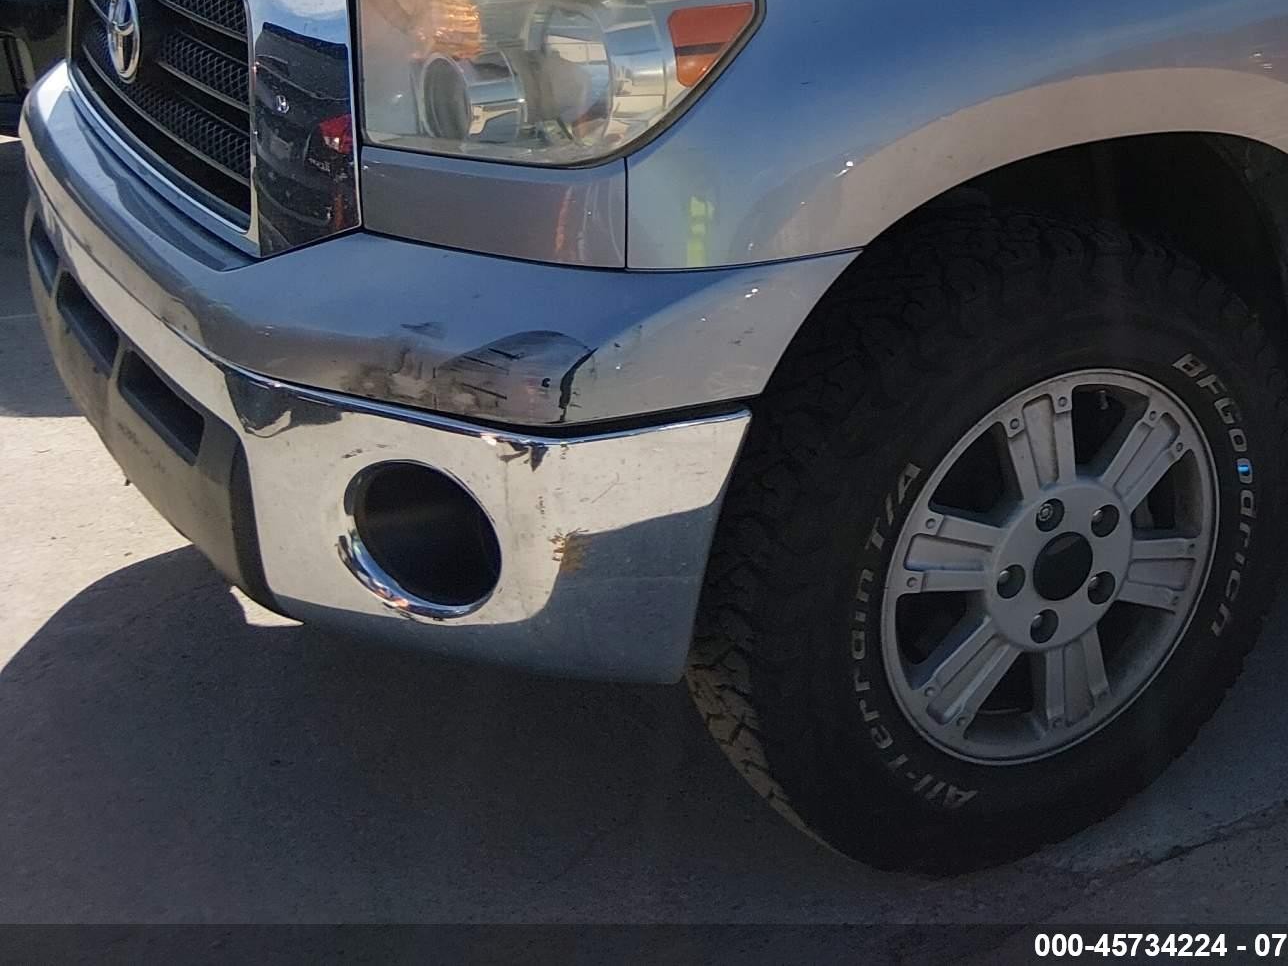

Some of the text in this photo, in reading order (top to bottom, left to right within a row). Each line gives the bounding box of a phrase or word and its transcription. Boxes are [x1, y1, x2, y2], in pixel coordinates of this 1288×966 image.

[851, 462, 978, 808] All-Terrain T/A
[1171, 352, 1257, 637] BFGoodrich
